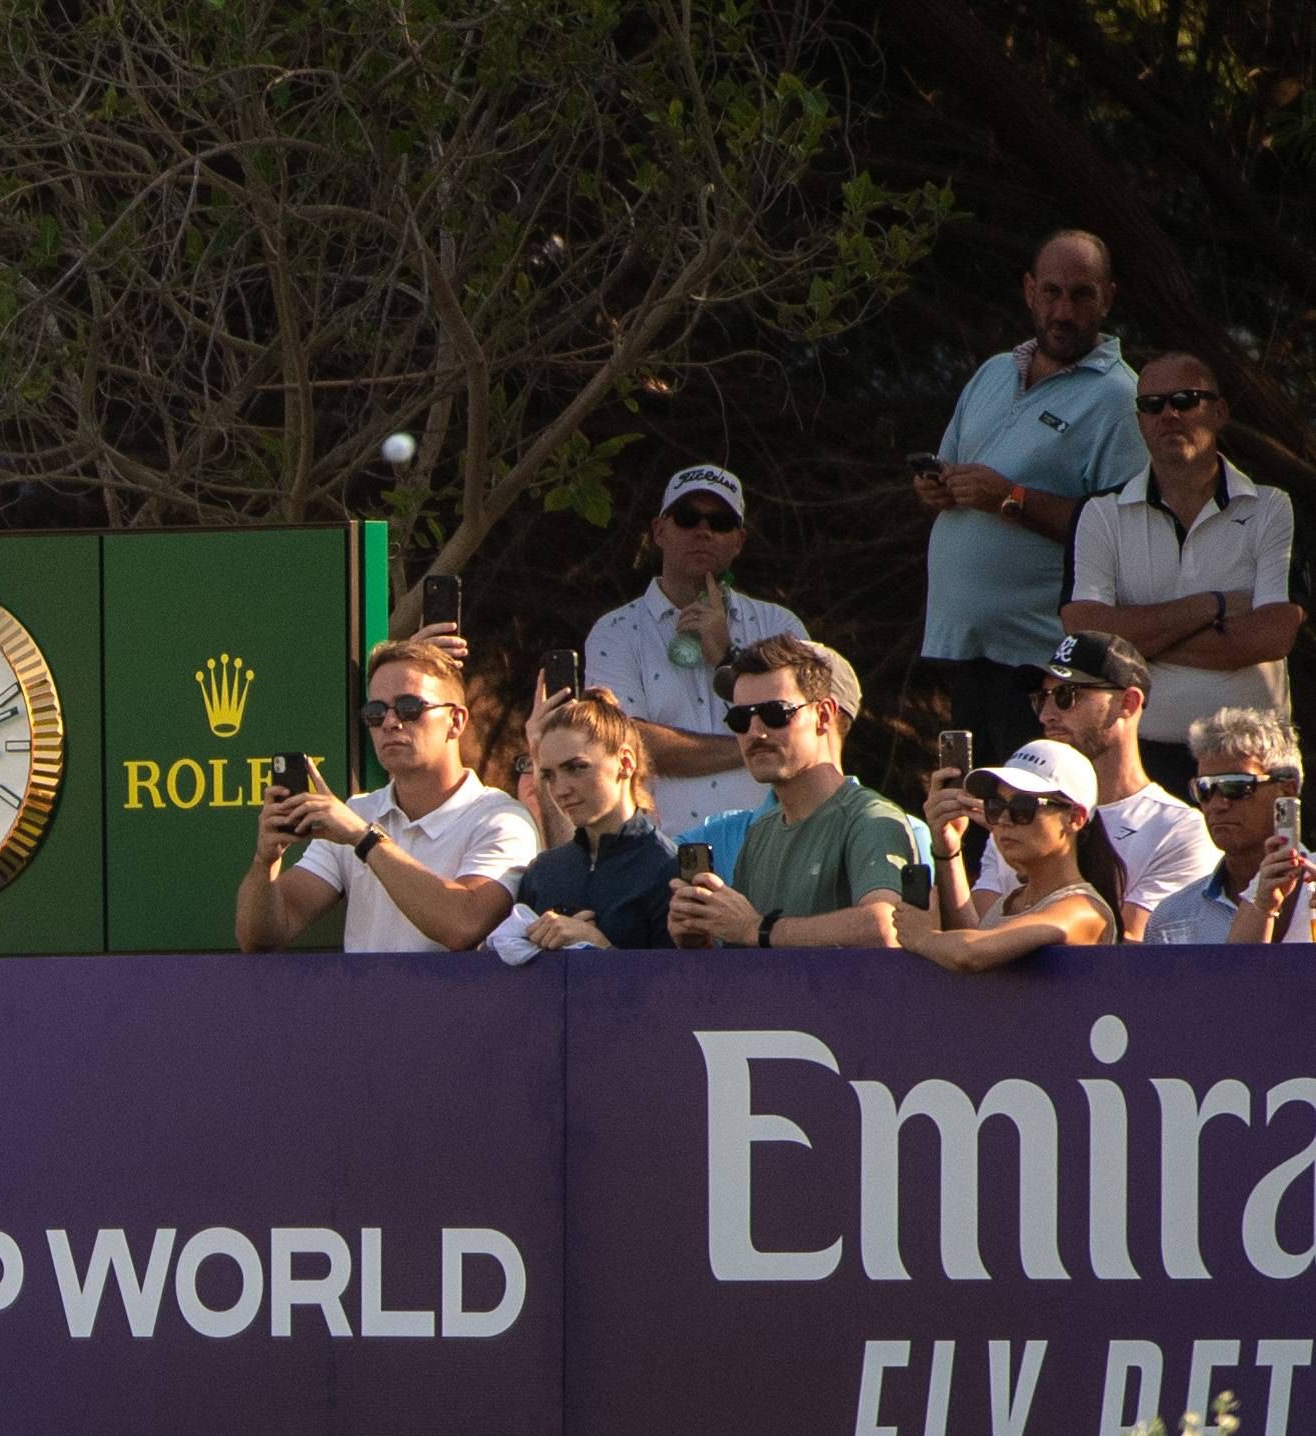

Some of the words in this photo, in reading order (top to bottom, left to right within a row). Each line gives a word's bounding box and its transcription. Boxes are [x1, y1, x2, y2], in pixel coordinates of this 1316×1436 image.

[123, 757, 325, 809] ROLE
[692, 1014, 1316, 1281] Emira
[45, 1226, 526, 1338] WORLD
